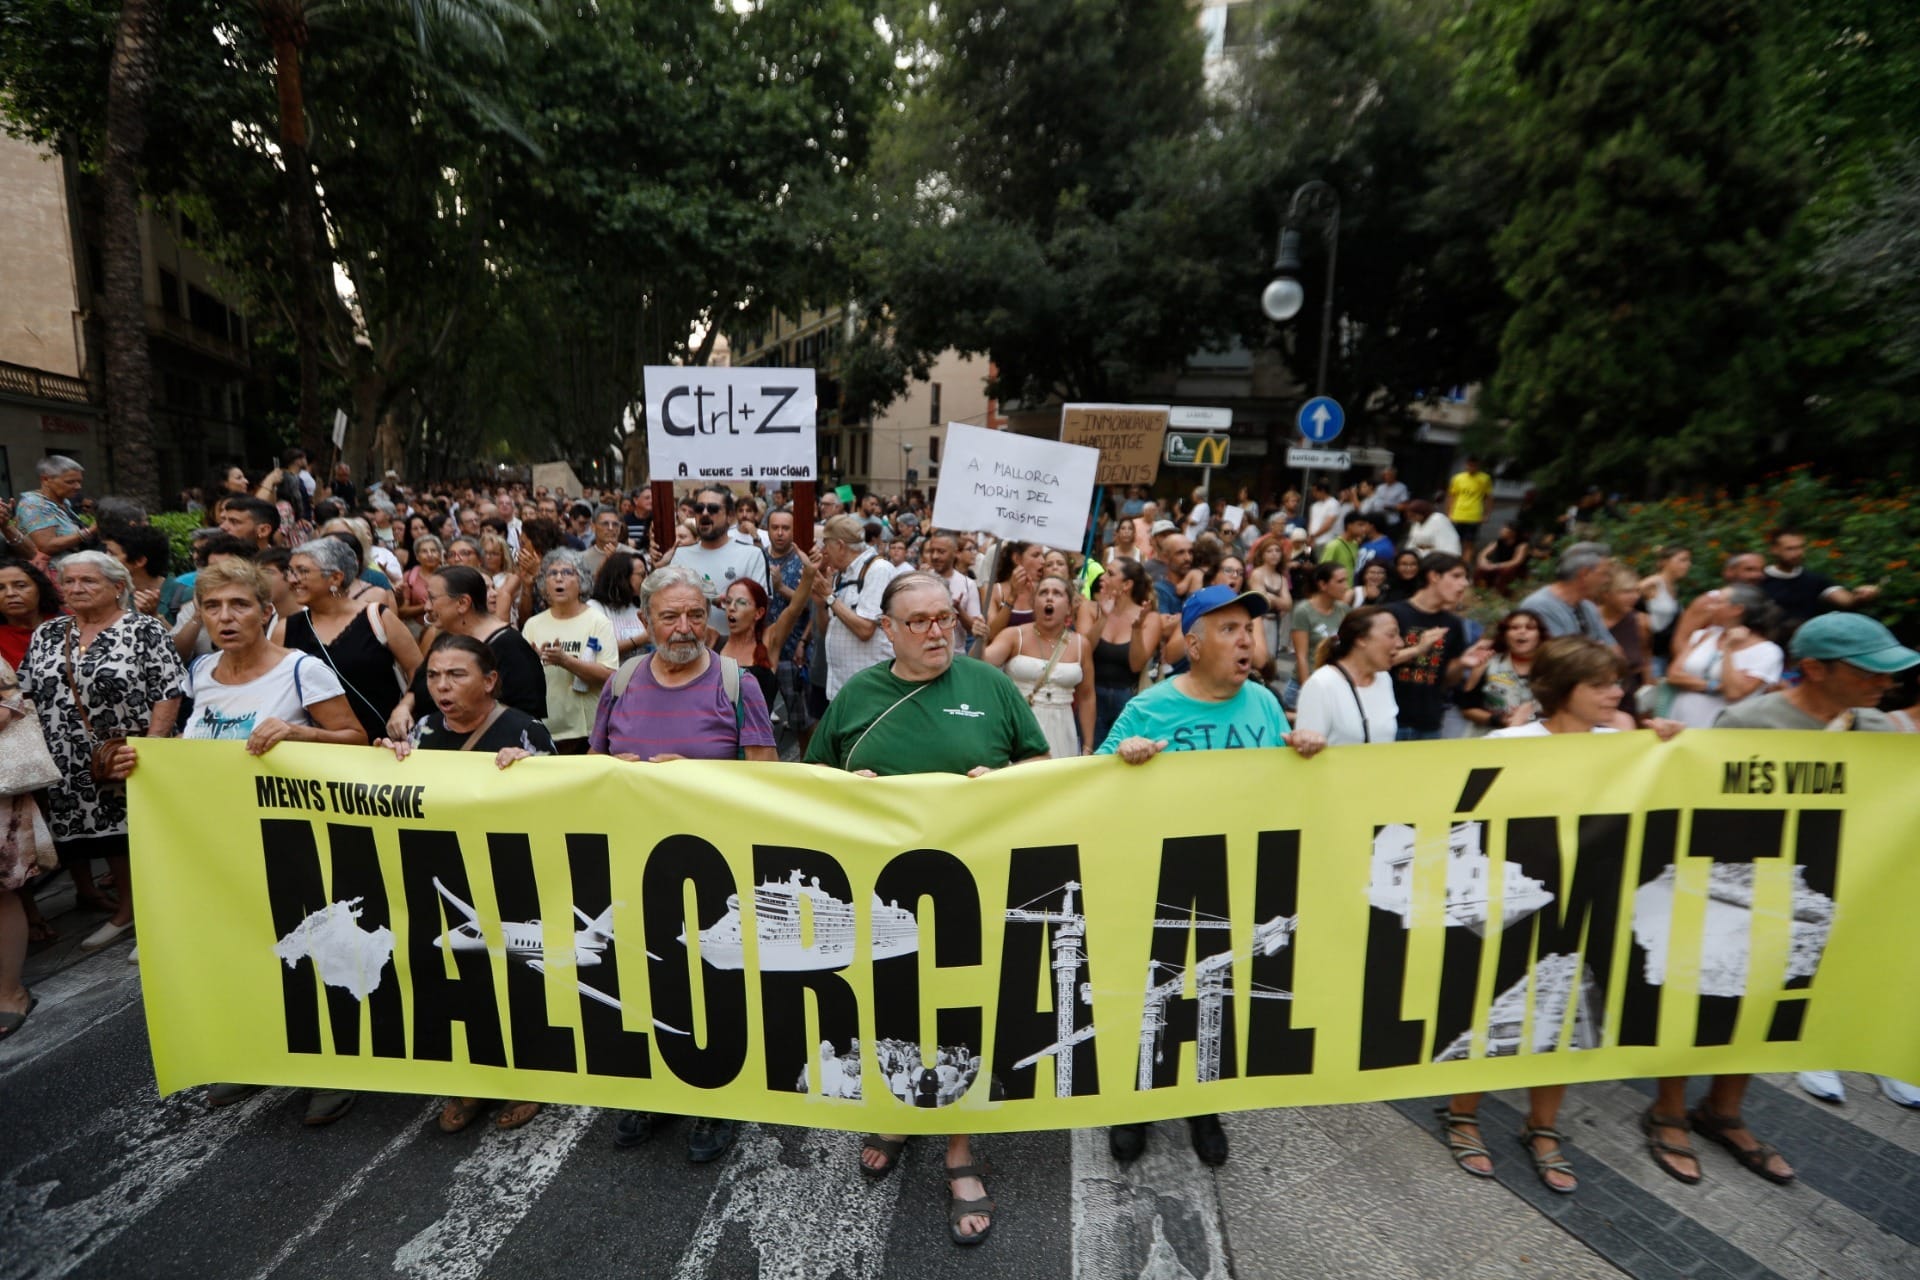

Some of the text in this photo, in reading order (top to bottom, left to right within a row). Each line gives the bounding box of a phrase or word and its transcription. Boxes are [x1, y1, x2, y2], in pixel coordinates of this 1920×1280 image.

[661, 384, 801, 436] Ctrl+Z
[678, 462, 688, 476] A
[968, 457, 1060, 486] A MALLORCA
[1027, 489, 1053, 504] DEL
[1174, 724, 1265, 751] STAY
[1721, 754, 1847, 794] MÉS VIDA
[255, 775, 426, 819] MENYS TURISME
[260, 766, 1846, 1109] MALLORCA AL LÍMIT!
